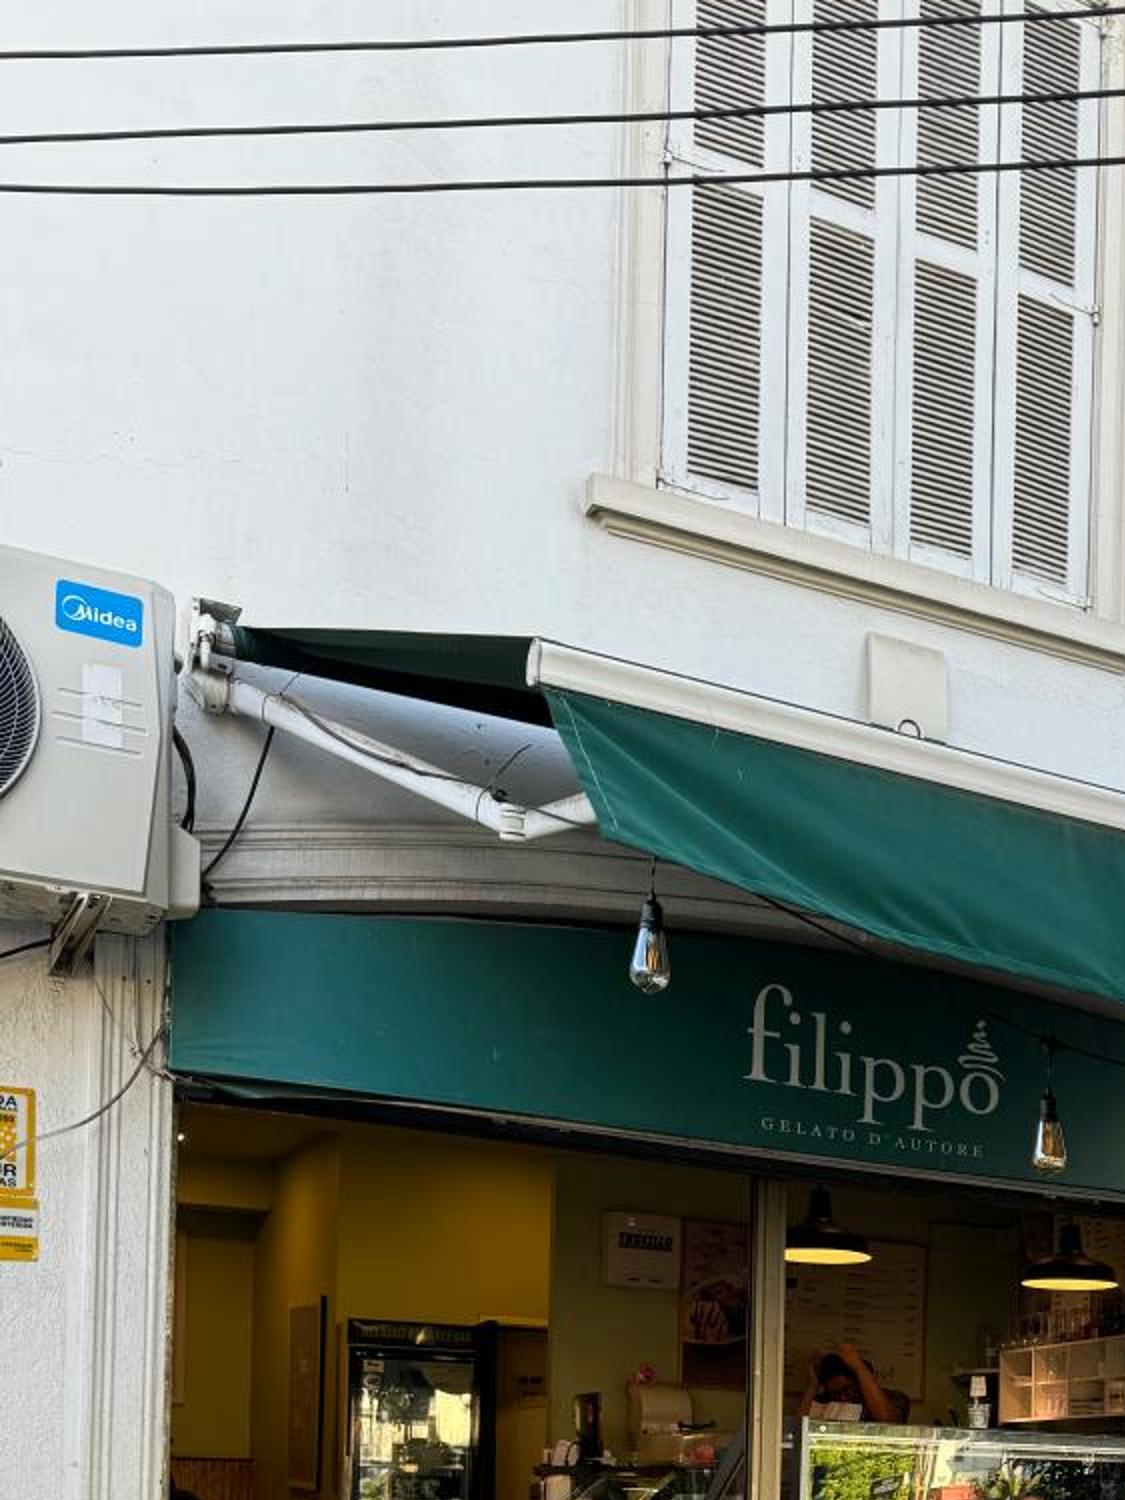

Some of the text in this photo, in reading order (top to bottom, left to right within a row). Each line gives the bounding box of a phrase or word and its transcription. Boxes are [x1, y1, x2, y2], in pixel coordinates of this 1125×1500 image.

[65, 599, 136, 632] Midea
[742, 984, 1002, 1132] filippo
[0, 1095, 18, 1106] A
[761, 1117, 984, 1158] GELATO D'AUTORE
